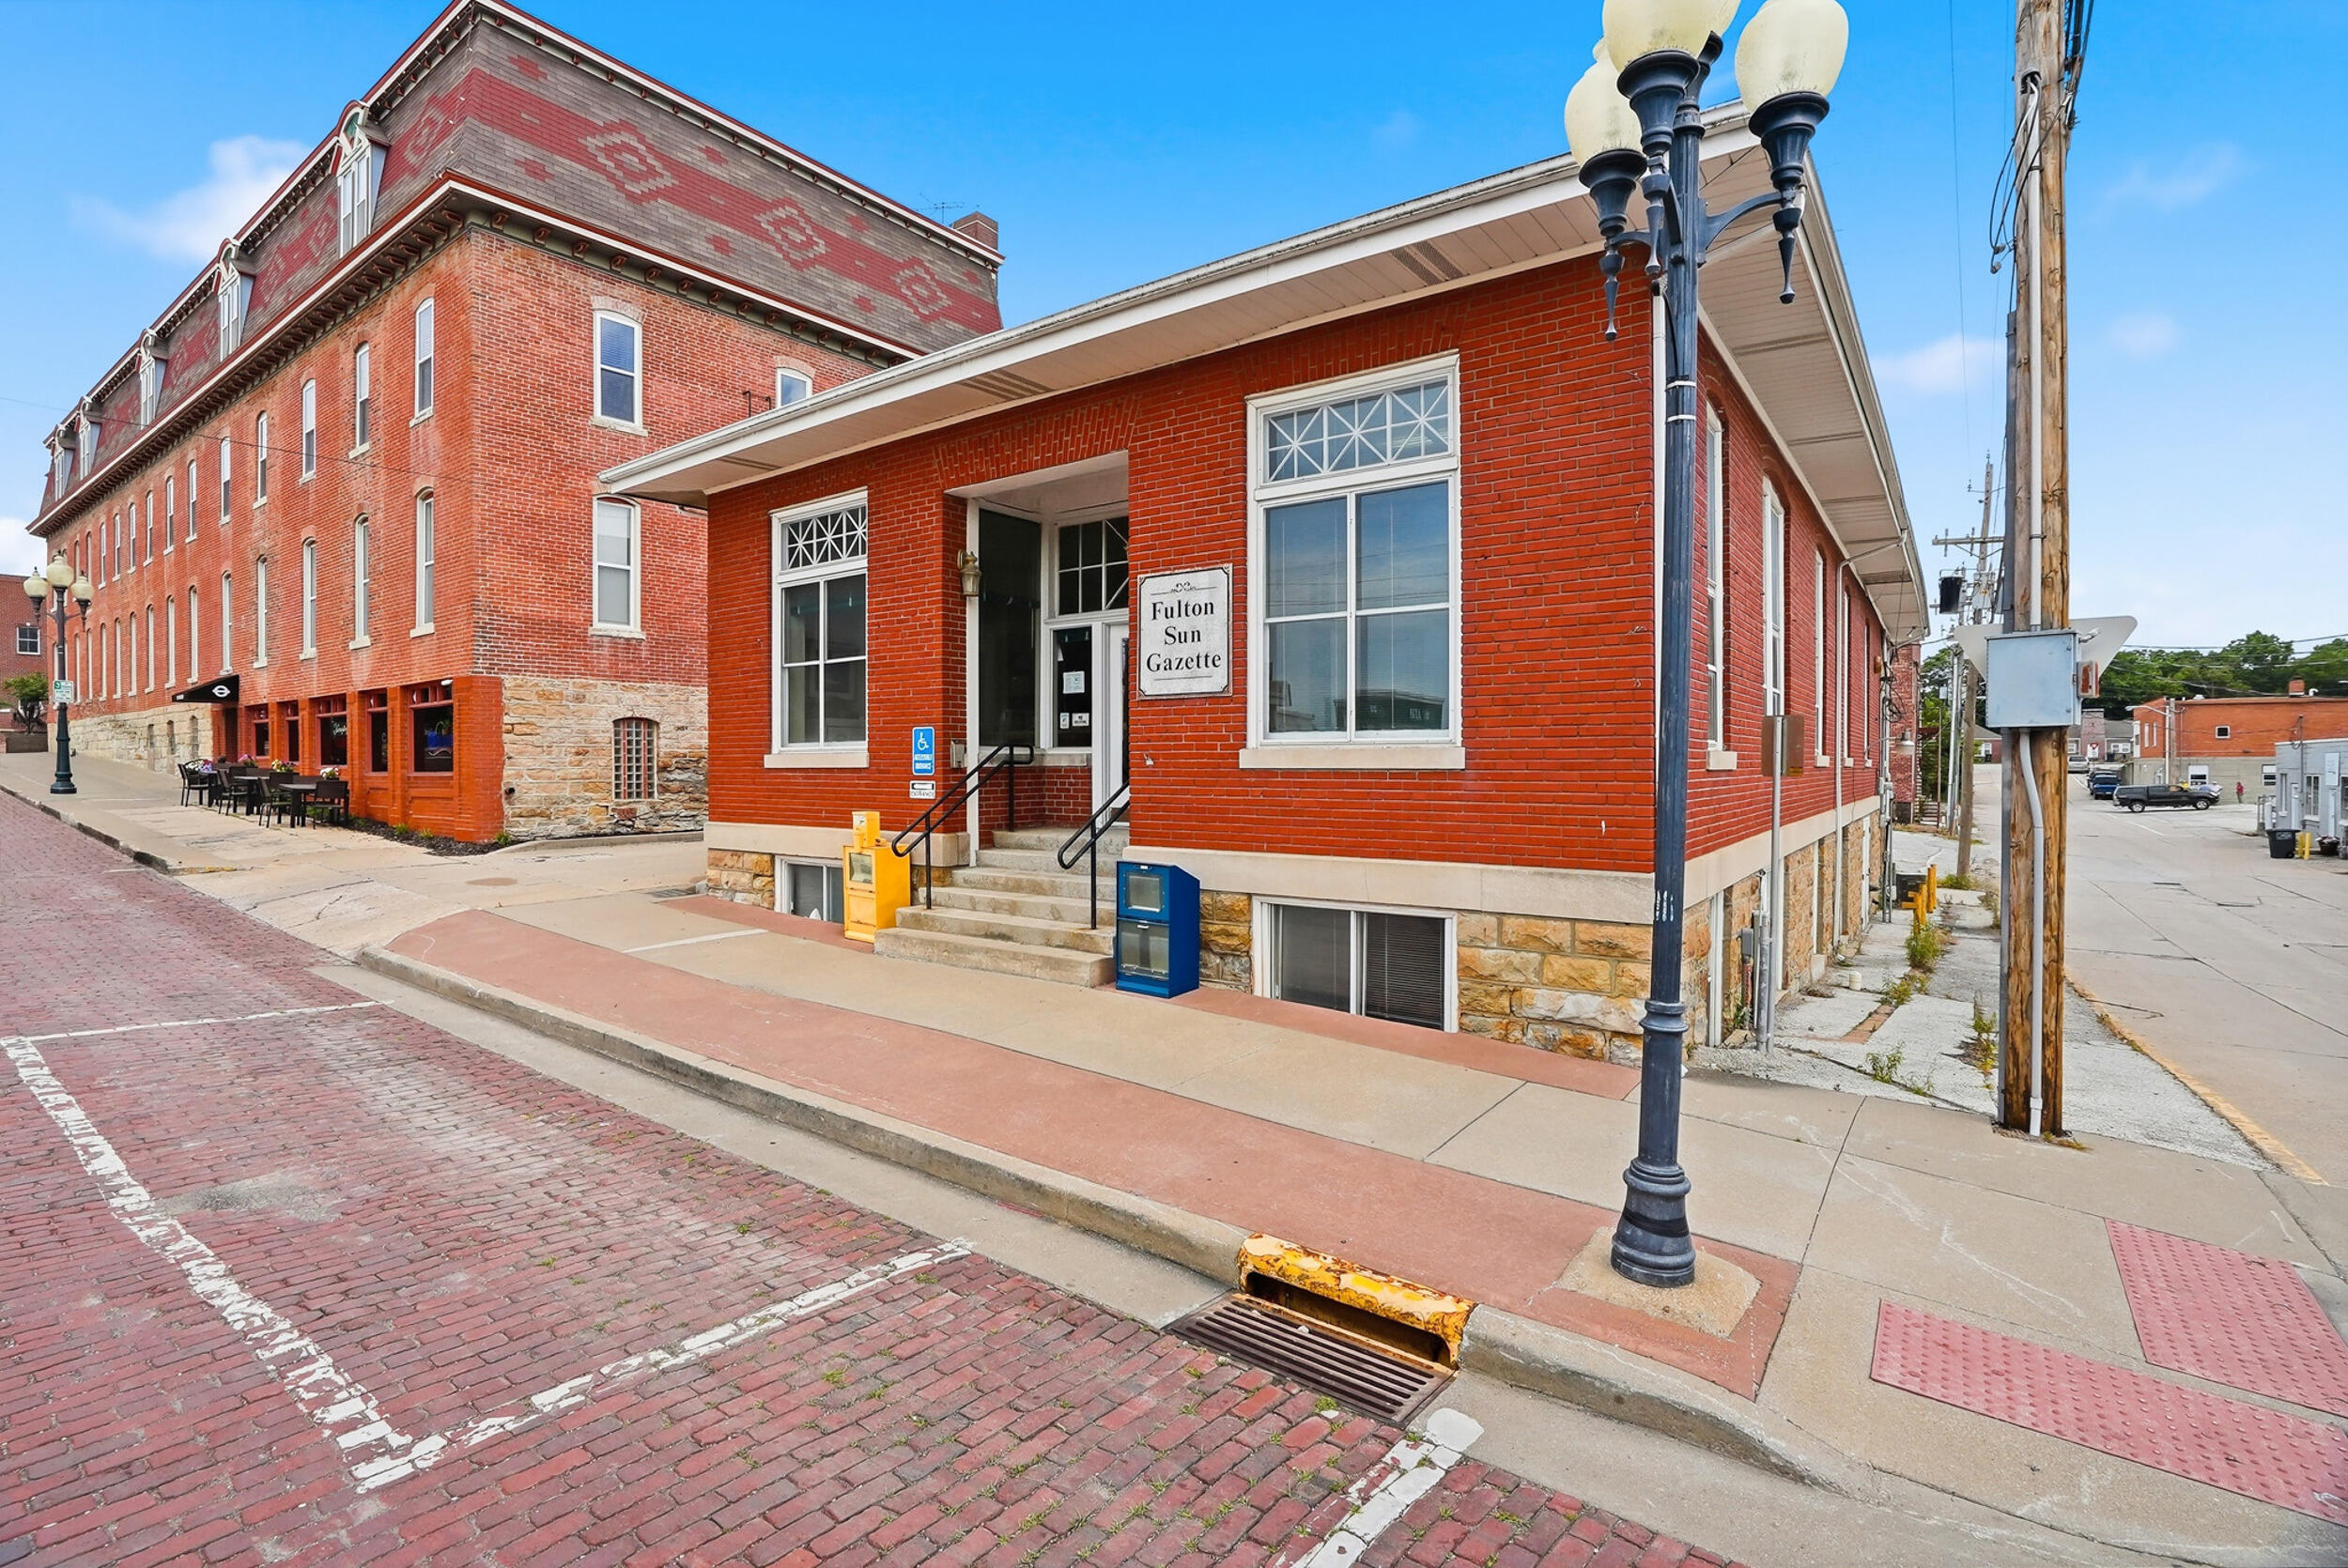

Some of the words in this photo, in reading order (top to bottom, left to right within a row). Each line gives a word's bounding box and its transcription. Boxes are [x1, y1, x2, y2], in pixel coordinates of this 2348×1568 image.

[1151, 600, 1214, 621] Fulton
[1164, 625, 1201, 645] Sun
[1146, 652, 1222, 673] Gazette
